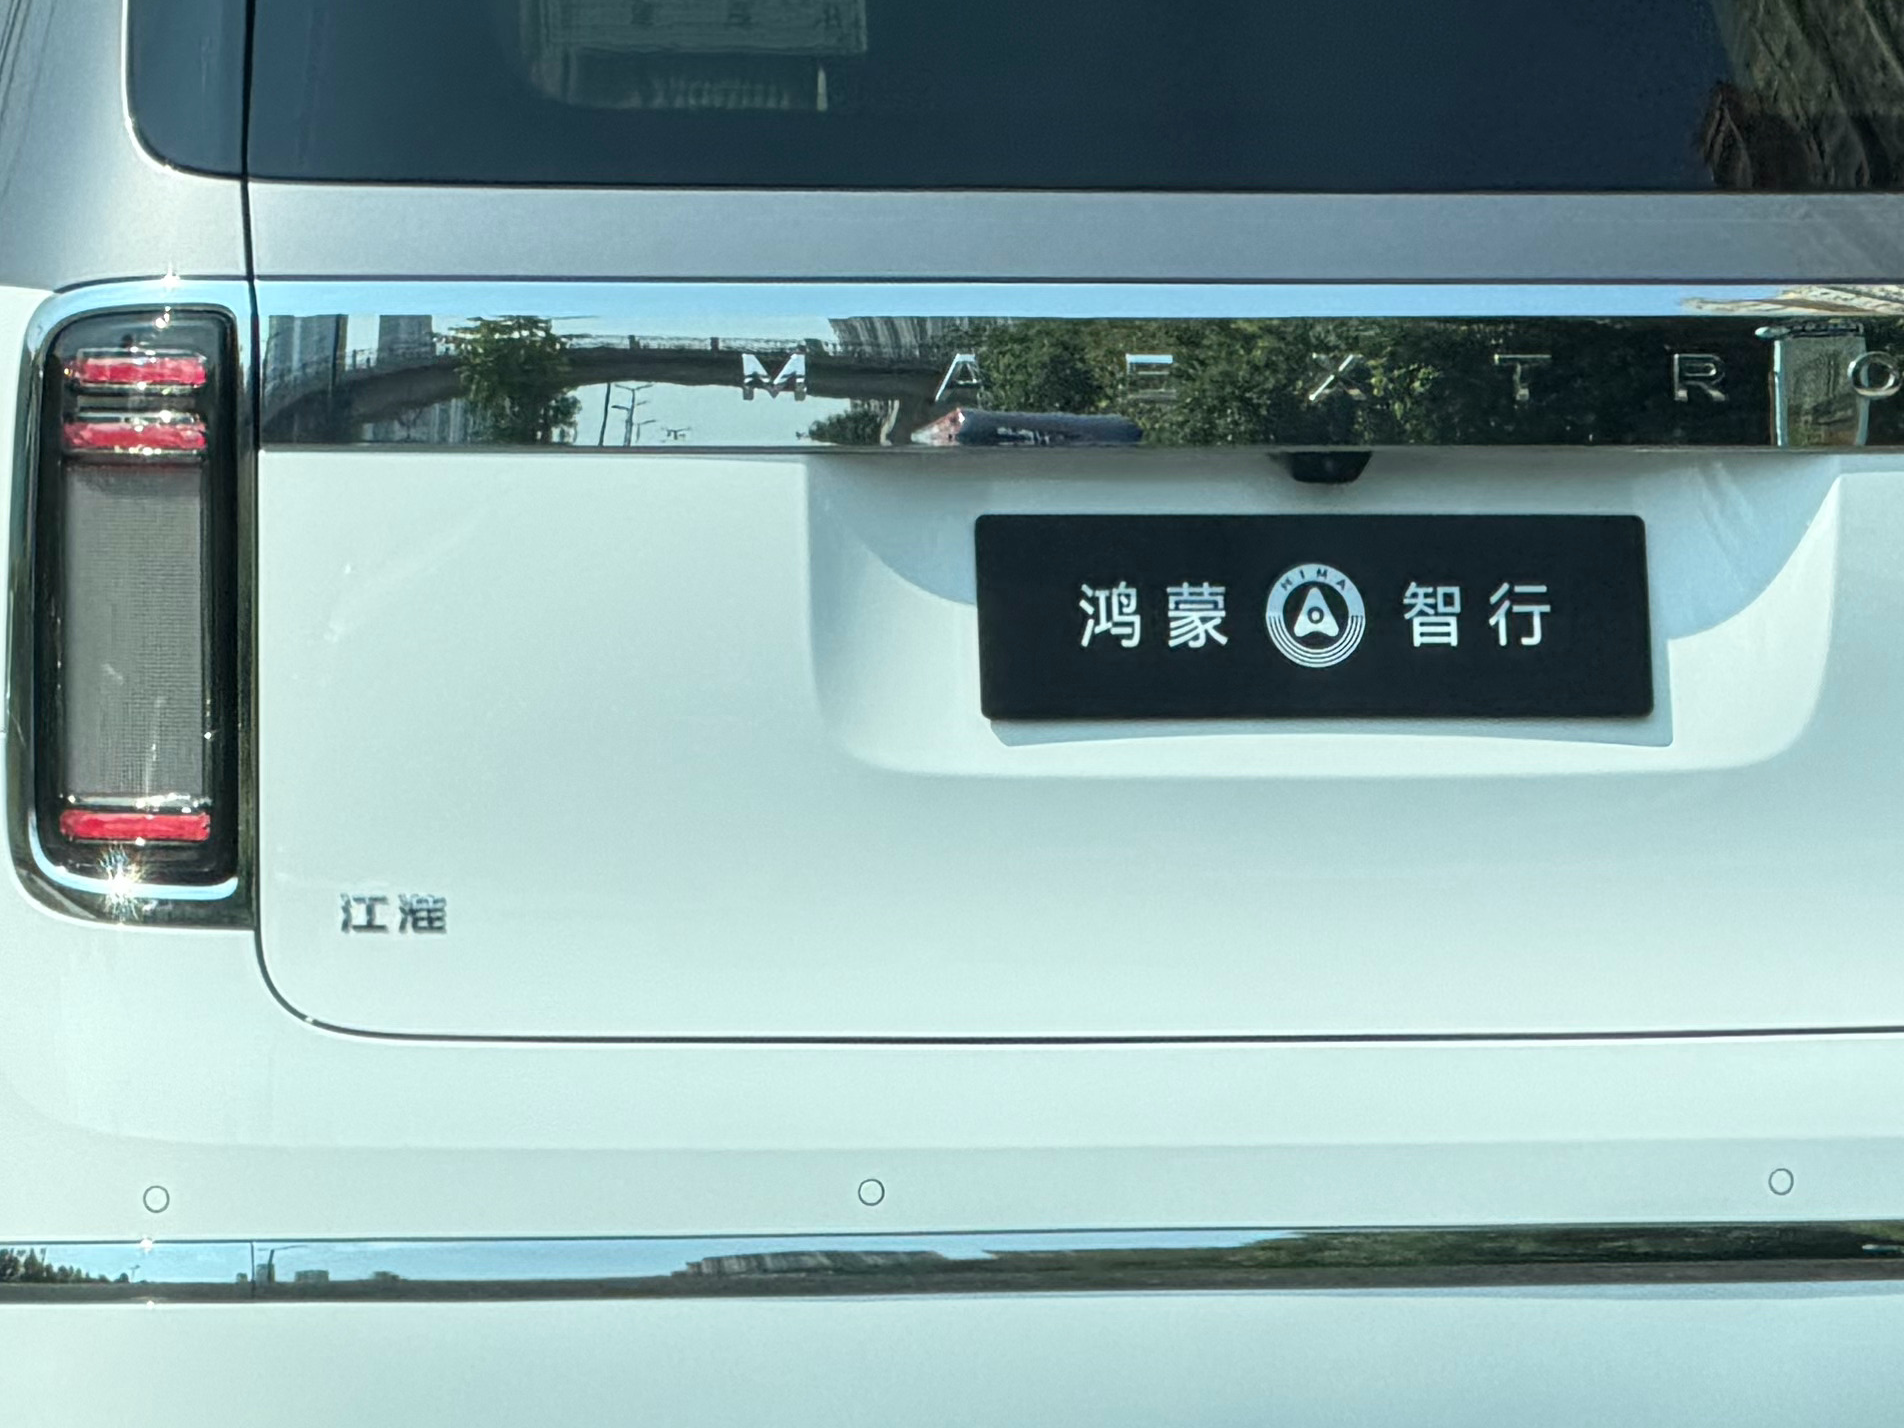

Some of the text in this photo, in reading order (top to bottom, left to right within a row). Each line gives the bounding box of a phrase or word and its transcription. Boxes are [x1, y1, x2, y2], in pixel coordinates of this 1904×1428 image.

[742, 351, 1902, 402] MAEXTRO
[1078, 580, 1552, 649] 鸿蒙 智行
